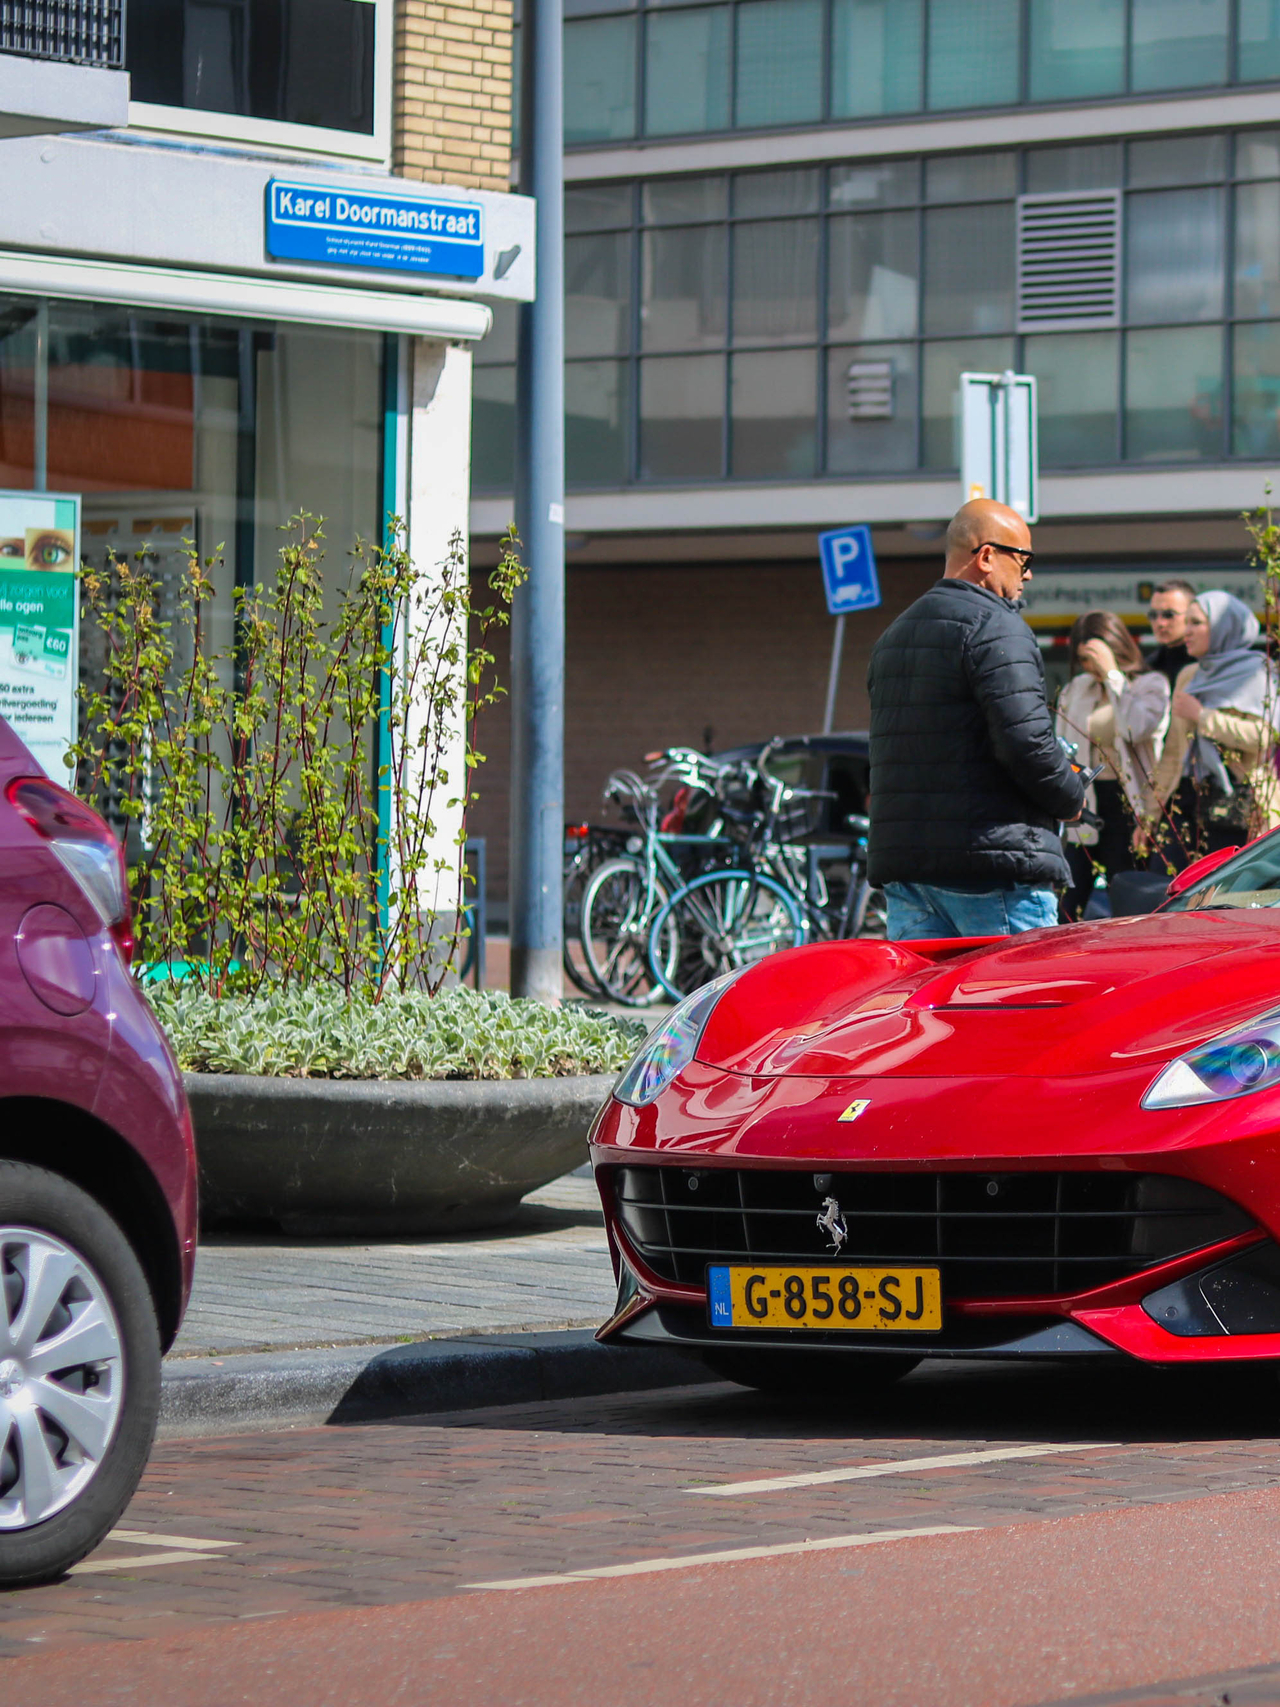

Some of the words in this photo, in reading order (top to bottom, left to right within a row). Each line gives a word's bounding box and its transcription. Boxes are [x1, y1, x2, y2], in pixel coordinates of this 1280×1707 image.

[280, 191, 330, 218] Karel
[336, 197, 476, 236] Doormanstraat
[831, 536, 859, 578] P
[16, 601, 44, 615] ogen
[715, 1302, 729, 1315] NL
[745, 1275, 924, 1320] G-858-SJ
